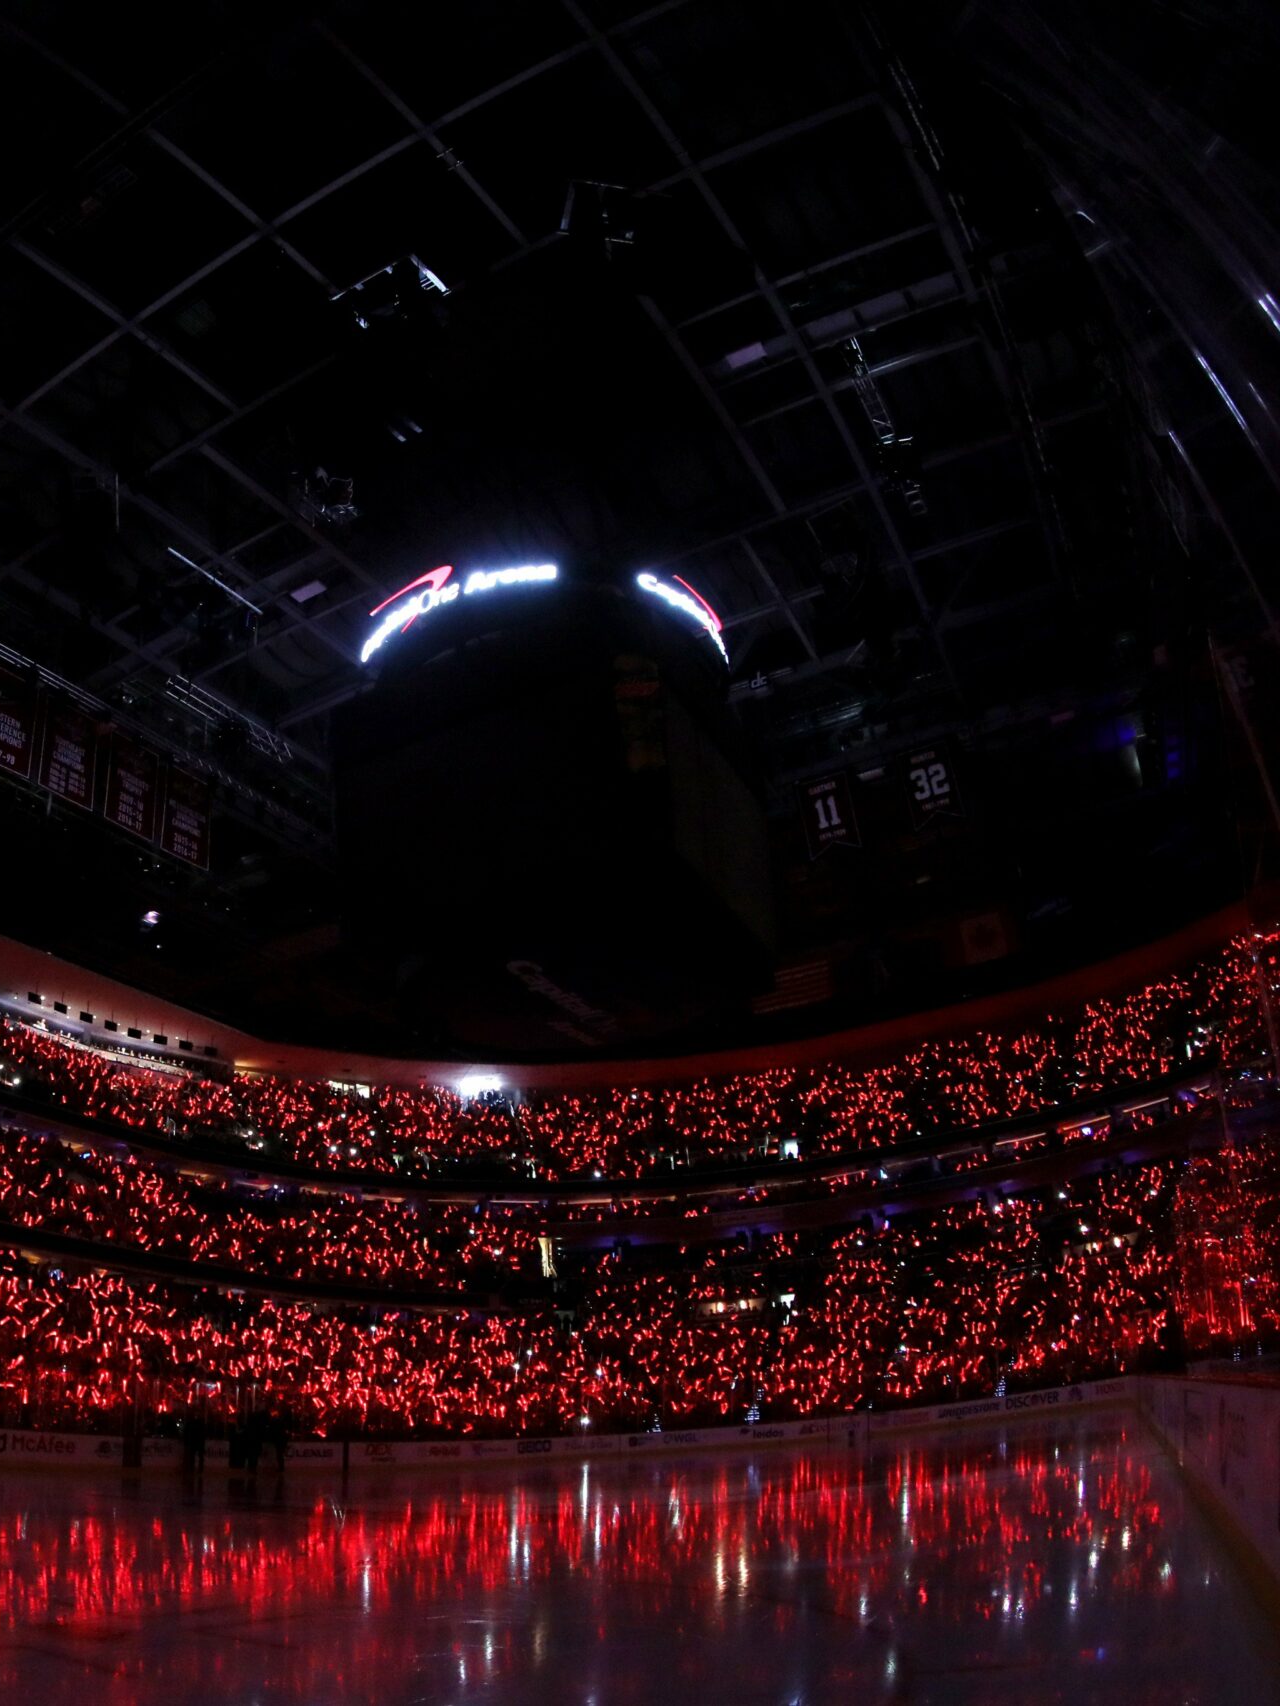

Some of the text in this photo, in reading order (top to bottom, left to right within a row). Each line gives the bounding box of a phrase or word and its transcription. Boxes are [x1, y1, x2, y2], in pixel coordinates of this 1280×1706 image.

[909, 763, 951, 801] 32
[814, 795, 842, 829] 11
[1005, 1391, 1059, 1410] DISCOVER
[675, 1432, 698, 1444] WGL
[753, 1428, 784, 1439] leidos
[12, 1433, 76, 1454] McAfee
[517, 1439, 552, 1454] GEICO
[295, 1448, 334, 1459] LEXUS
